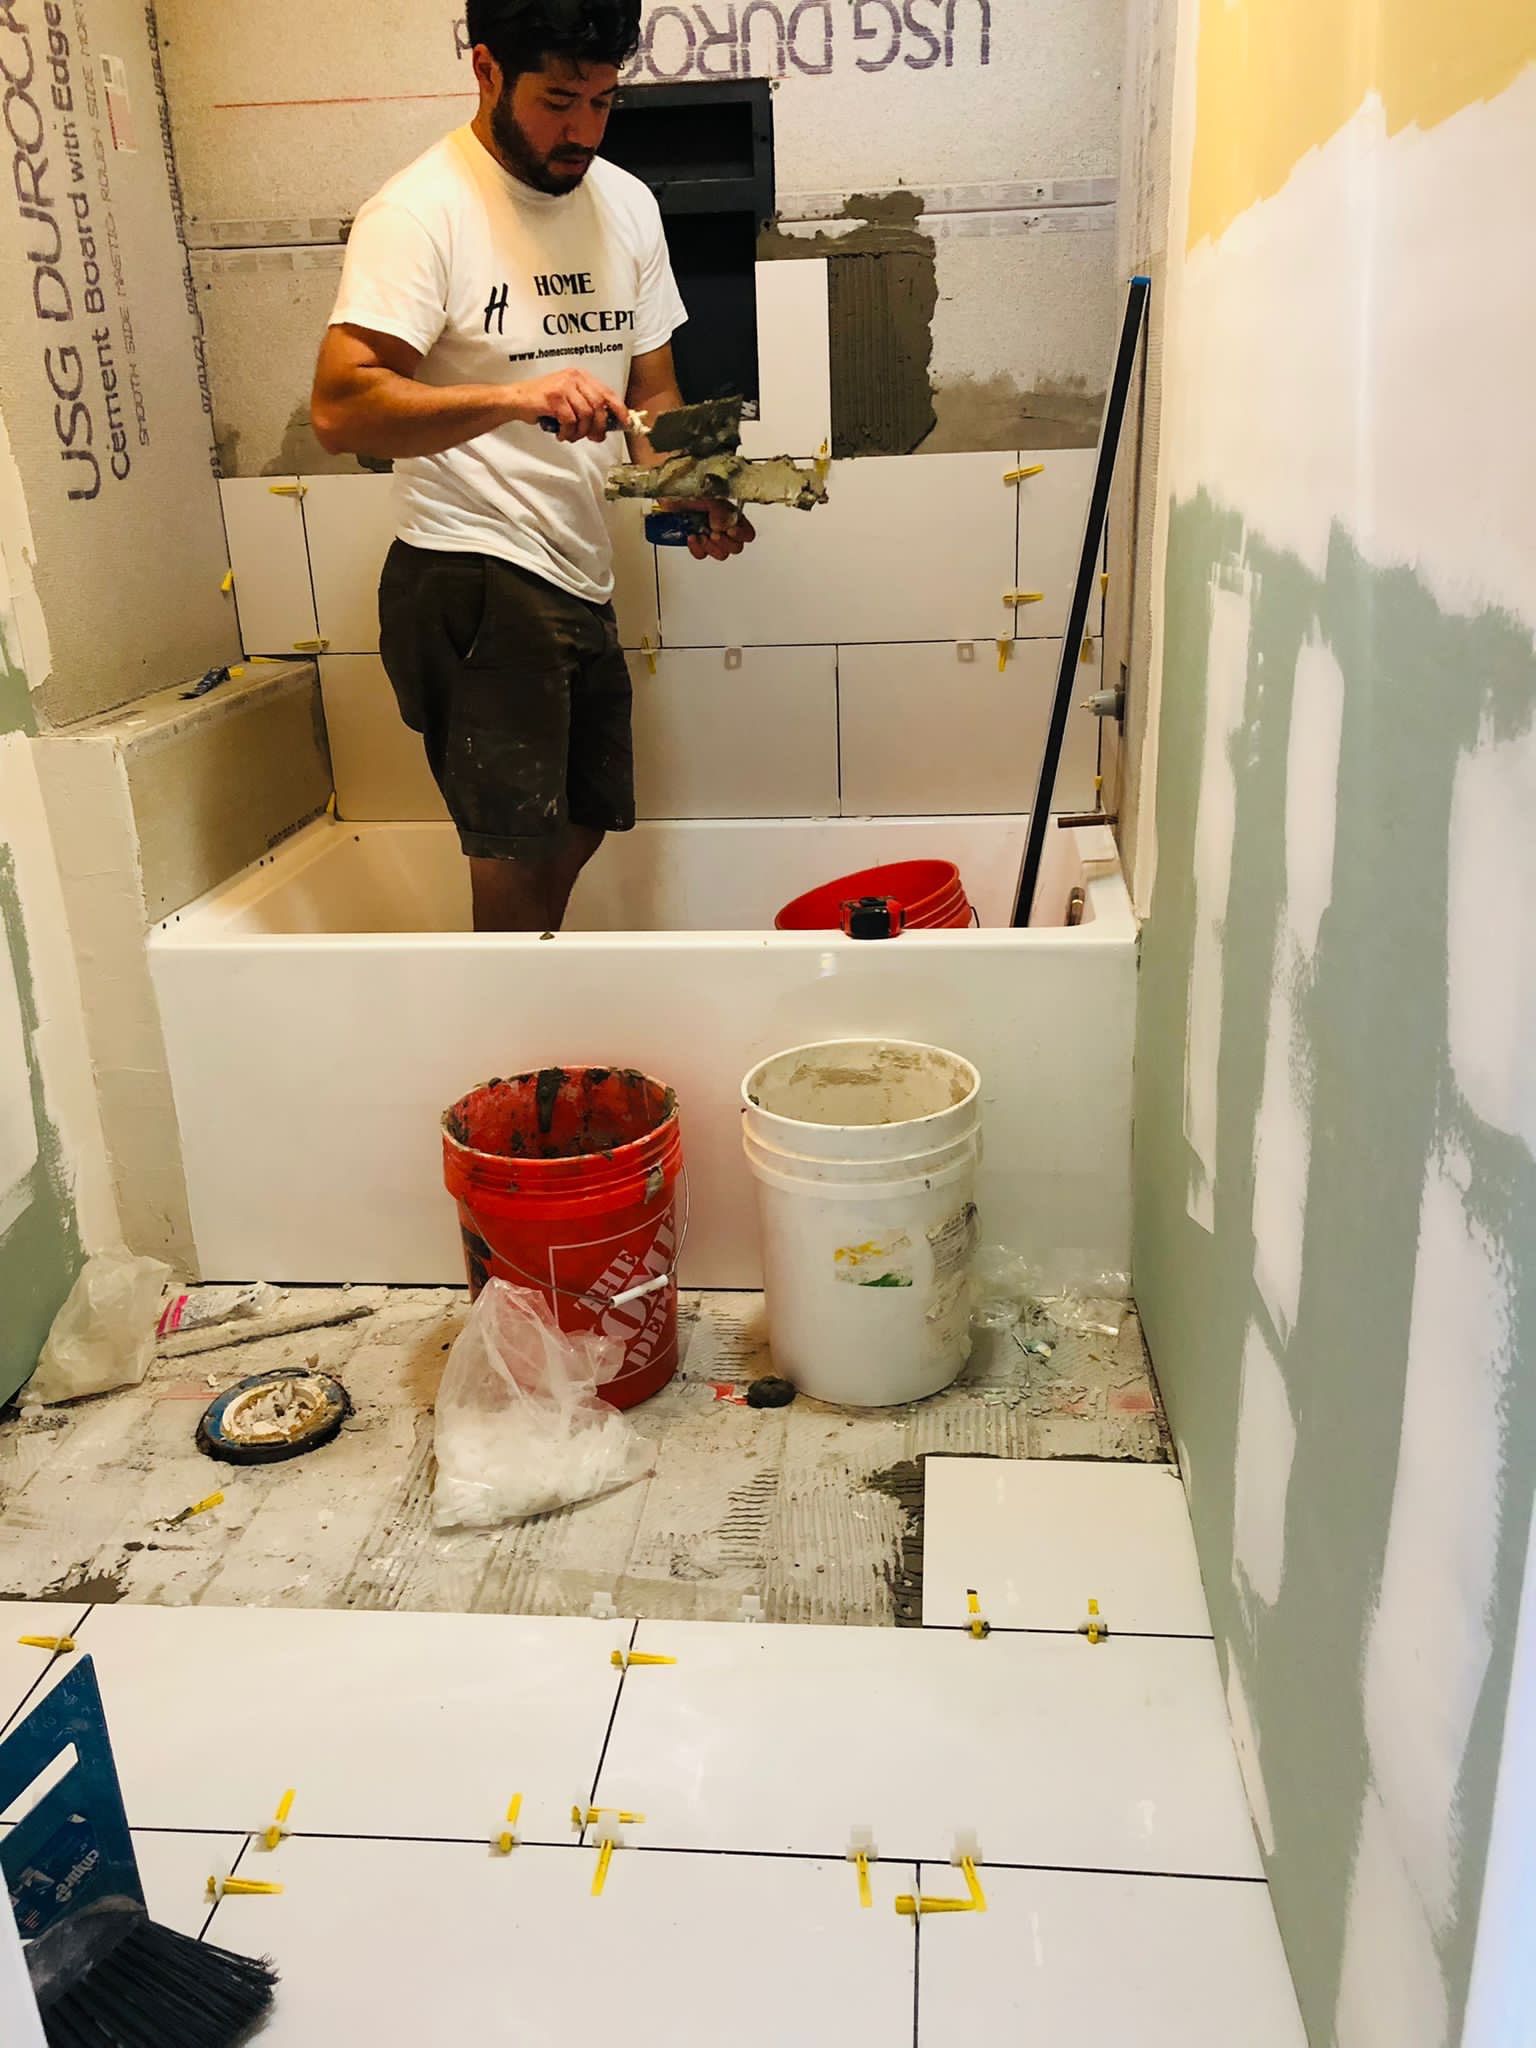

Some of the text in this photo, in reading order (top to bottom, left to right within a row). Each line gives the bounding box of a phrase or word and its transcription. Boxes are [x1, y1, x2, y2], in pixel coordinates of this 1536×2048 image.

[853, 0, 991, 73] USG
[82, 65, 99, 119] SIDE
[63, 121, 84, 183] with
[92, 126, 112, 202] ROUGH
[67, 192, 105, 313] Board
[533, 272, 595, 296] HOME
[120, 305, 135, 354] SIDE
[484, 282, 509, 335] H
[542, 310, 635, 336] CONCEPT
[508, 342, 624, 362] www.homeconceptsnj.com
[44, 345, 101, 500] USG
[92, 327, 130, 480] Cement
[129, 363, 150, 446] SMOOTH
[573, 1249, 640, 1315] THE
